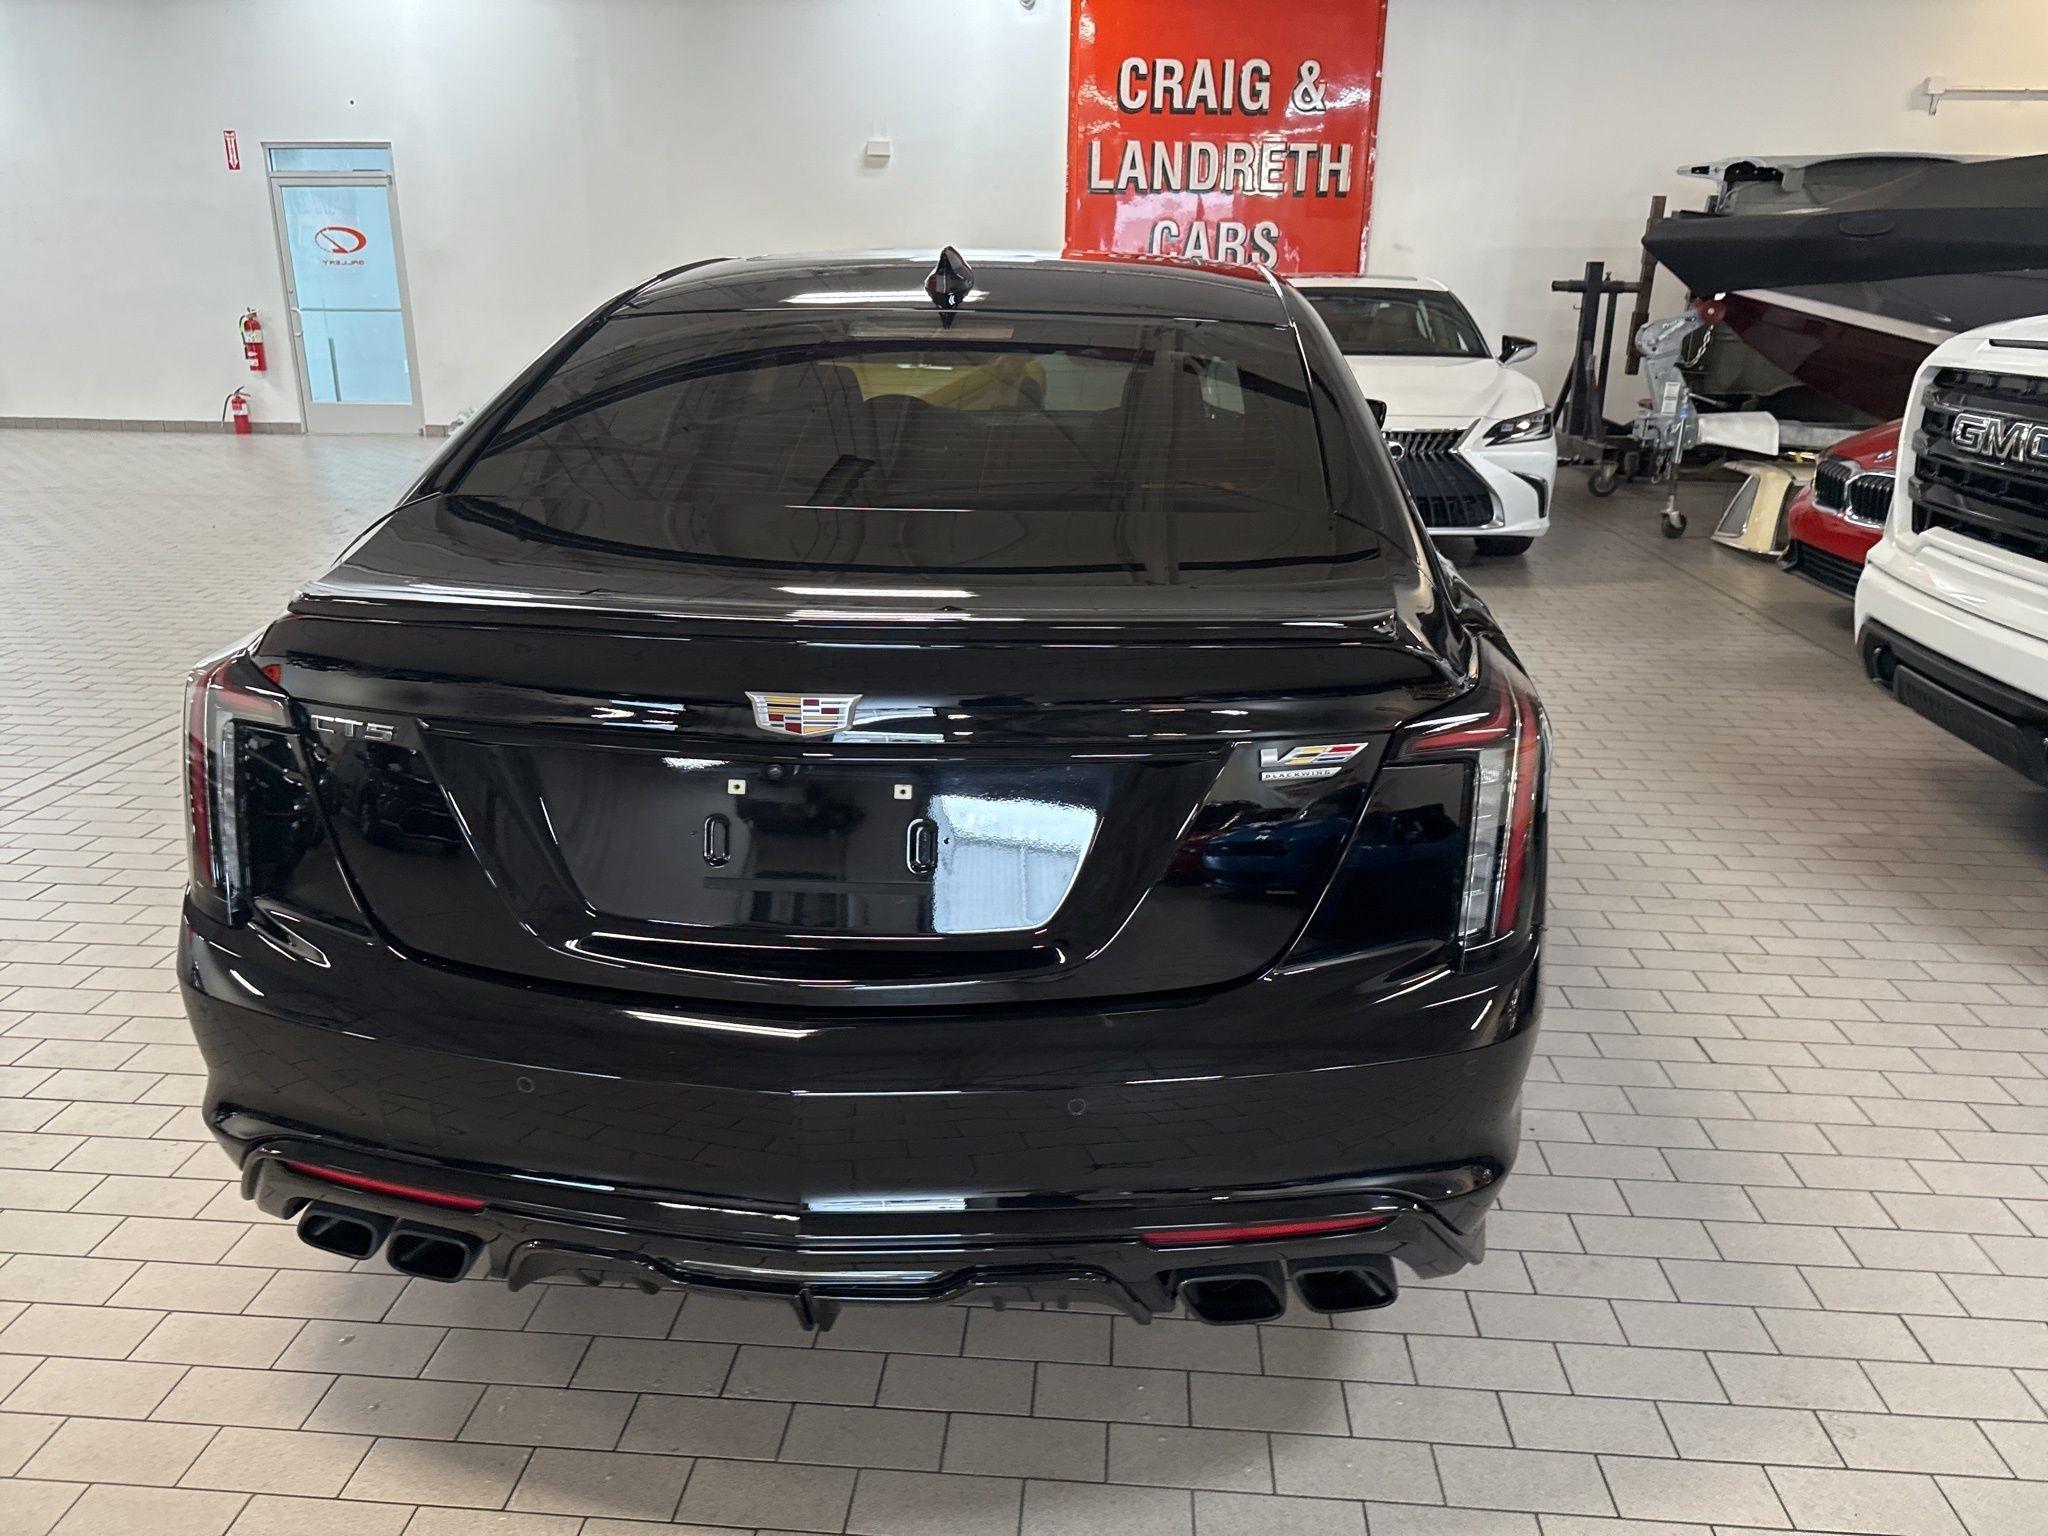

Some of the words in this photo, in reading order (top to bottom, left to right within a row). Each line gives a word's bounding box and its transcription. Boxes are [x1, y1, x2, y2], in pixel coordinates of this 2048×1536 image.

[1117, 57, 1272, 114] CRAIG
[1292, 59, 1328, 113] &
[1088, 139, 1353, 197] LANDRETH
[1149, 219, 1280, 270] CARS
[1951, 412, 2048, 462] GMC
[1265, 770, 1332, 779] BLACKWING
